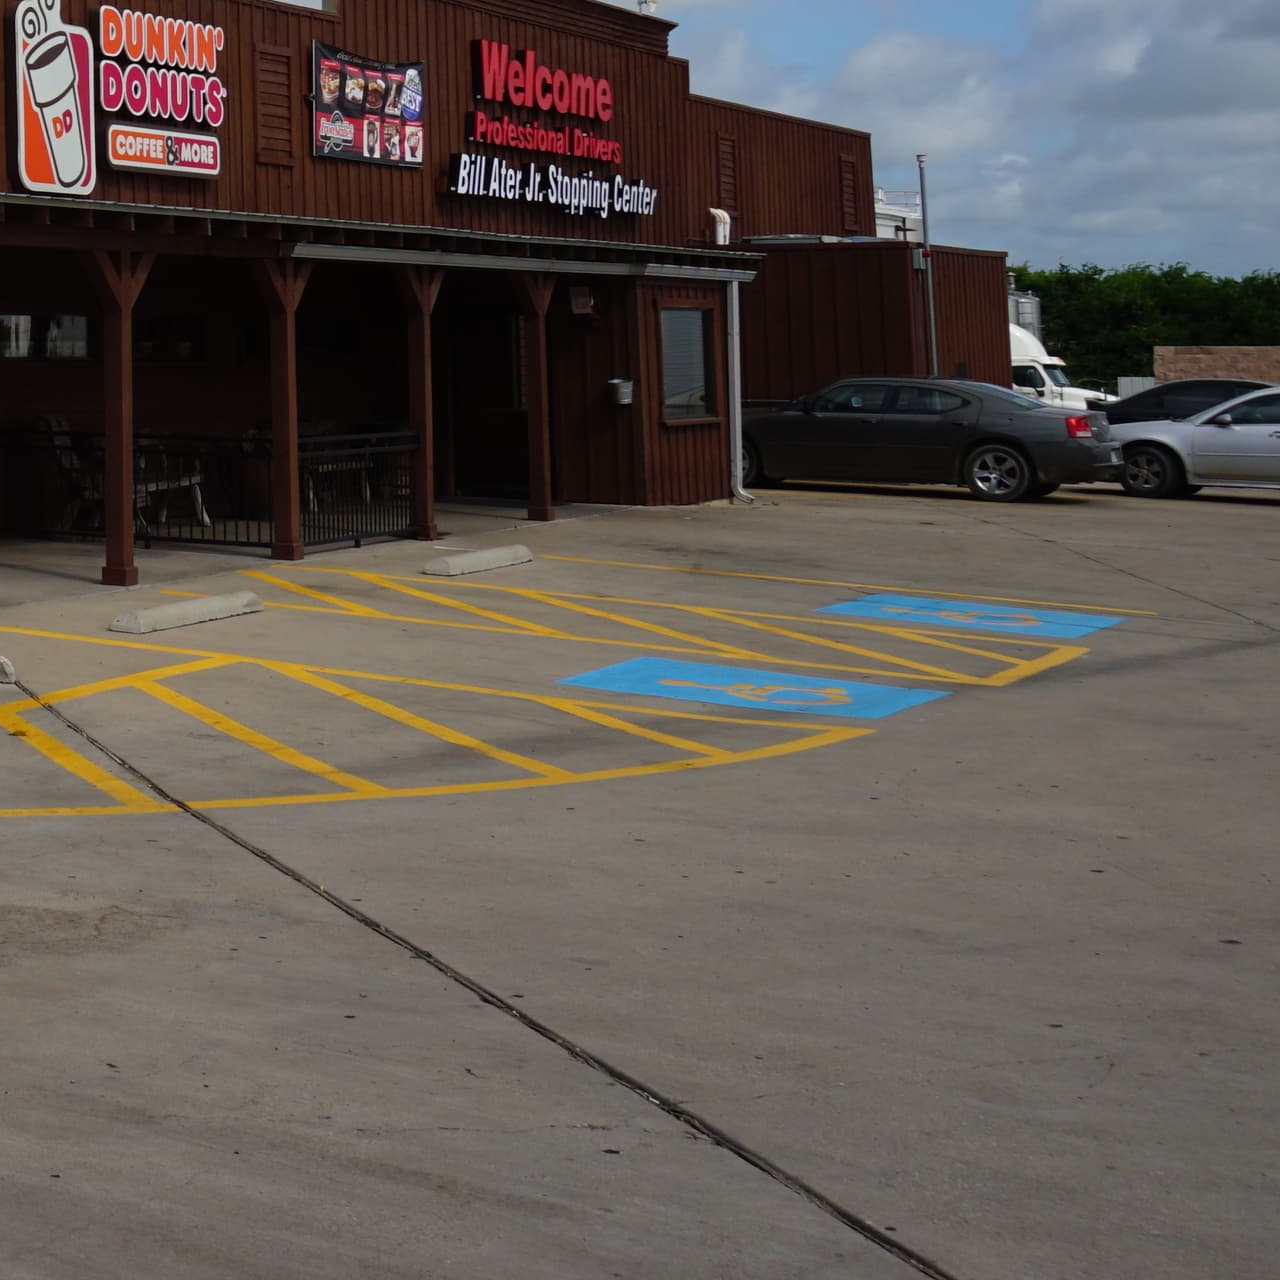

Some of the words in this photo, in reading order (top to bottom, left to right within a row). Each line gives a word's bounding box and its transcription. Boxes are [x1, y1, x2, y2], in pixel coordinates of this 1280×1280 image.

[99, 4, 224, 74] DUNKIN'
[99, 60, 225, 127] DONUTS
[480, 38, 614, 123] Welcome
[52, 109, 73, 139] DD
[115, 134, 164, 159] COFFEE
[165, 135, 179, 166] &
[180, 142, 215, 166] MORE
[474, 111, 571, 156] Professional
[573, 128, 622, 166] Drivers
[457, 153, 487, 197] Bill
[489, 157, 523, 200] Ater
[525, 162, 543, 202] Jr.
[547, 164, 610, 219] Stopping
[613, 174, 658, 216] Center
